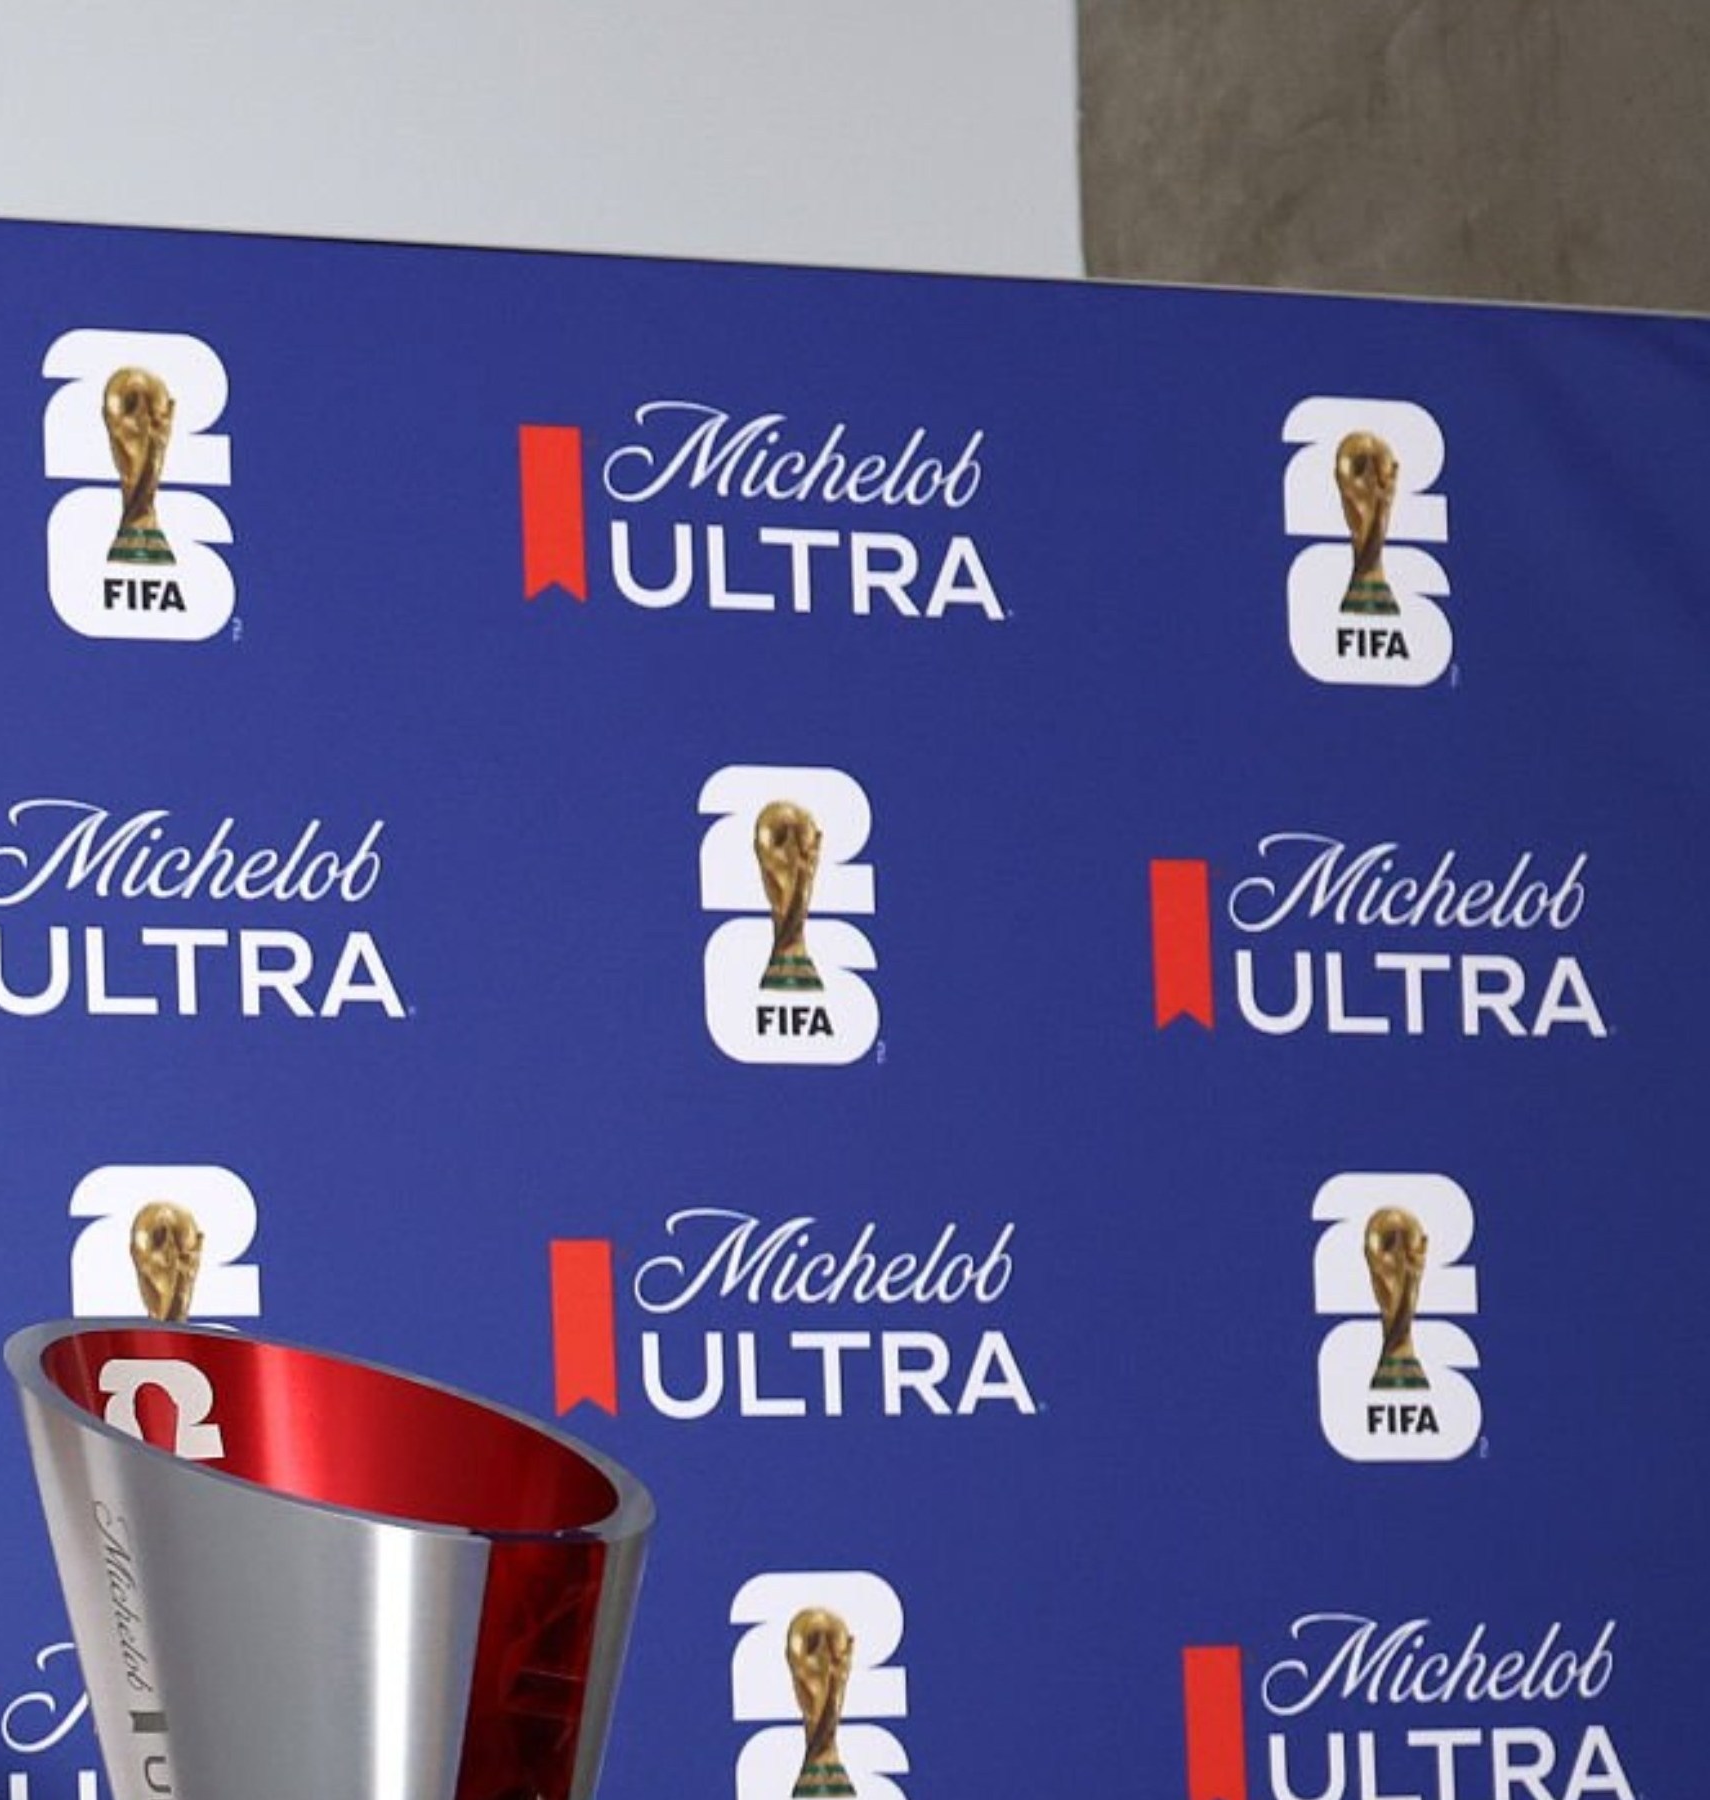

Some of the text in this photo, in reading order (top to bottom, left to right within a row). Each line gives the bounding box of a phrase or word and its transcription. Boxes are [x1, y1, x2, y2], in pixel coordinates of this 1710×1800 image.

[604, 402, 983, 507] Michelob
[104, 579, 185, 611] FIFA
[611, 521, 1004, 619] ULTRA
[1338, 629, 1408, 658] FIFA
[1229, 834, 1586, 931] Michelob
[757, 1006, 833, 1035] FIFA
[1236, 950, 1606, 1036] ULTRA
[635, 1209, 1014, 1313] Michelob
[642, 1331, 1035, 1419] ULTRA
[1368, 1406, 1438, 1433] FIFA
[93, 1500, 153, 1692] Michelob
[1262, 1614, 1615, 1715] Michelob
